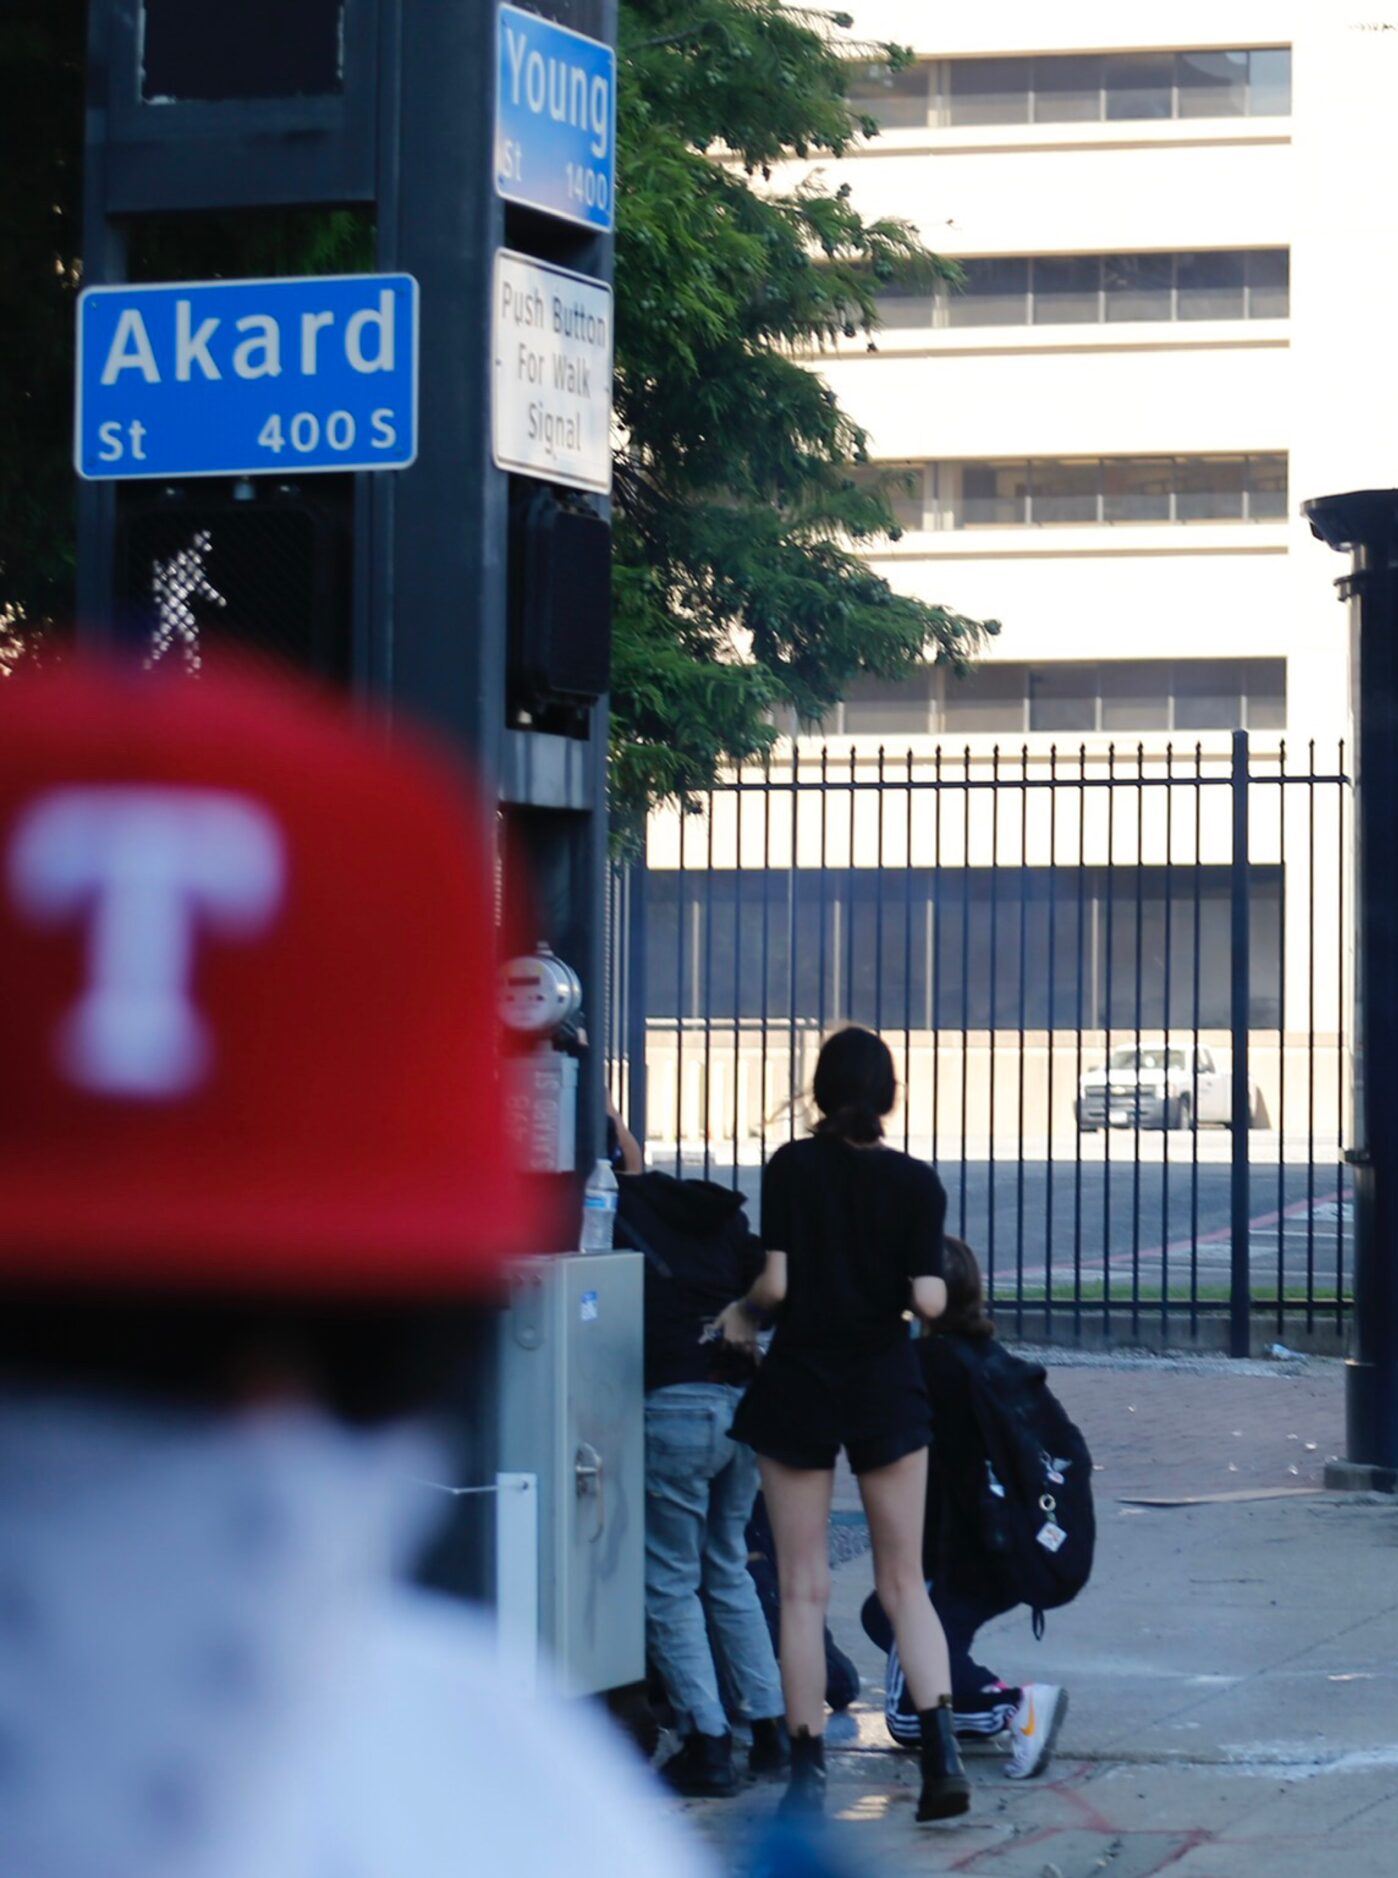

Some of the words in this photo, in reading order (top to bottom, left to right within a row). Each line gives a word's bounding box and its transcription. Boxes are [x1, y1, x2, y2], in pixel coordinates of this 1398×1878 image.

[507, 28, 608, 159] Young
[501, 139, 522, 182] St
[566, 161, 608, 210] 1400
[100, 289, 395, 385] Akard
[502, 282, 545, 328] Push
[552, 297, 606, 349] Button
[517, 342, 544, 383] For
[552, 353, 591, 399] Walk
[98, 420, 147, 461] St
[258, 411, 356, 453] 400
[371, 408, 397, 448] S
[528, 402, 581, 458] Signal
[8, 788, 284, 1095] T
